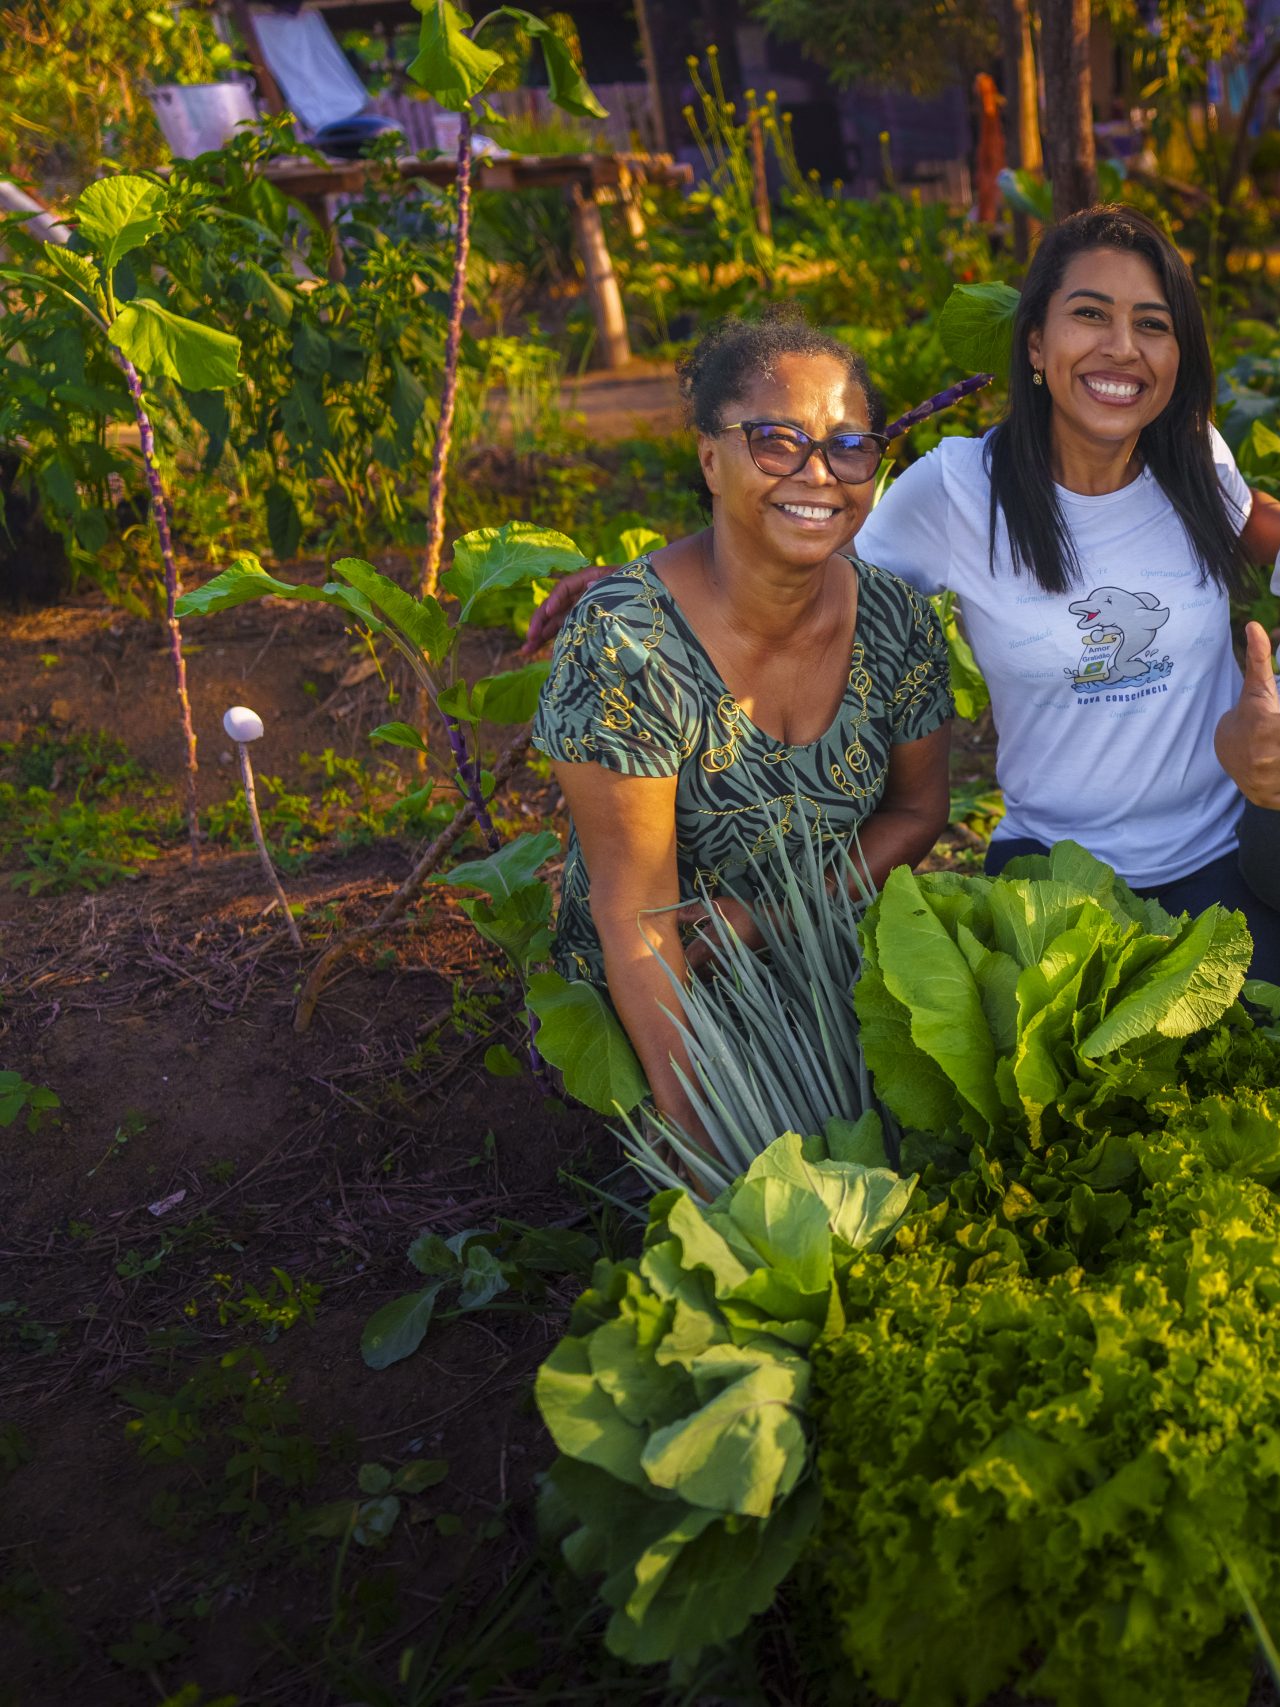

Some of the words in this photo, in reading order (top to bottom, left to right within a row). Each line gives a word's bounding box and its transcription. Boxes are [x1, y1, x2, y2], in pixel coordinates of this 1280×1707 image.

[1089, 645, 1111, 654] Amor
[1077, 695, 1100, 705] NOVA
[1105, 684, 1168, 703] CONSCIENCIA
